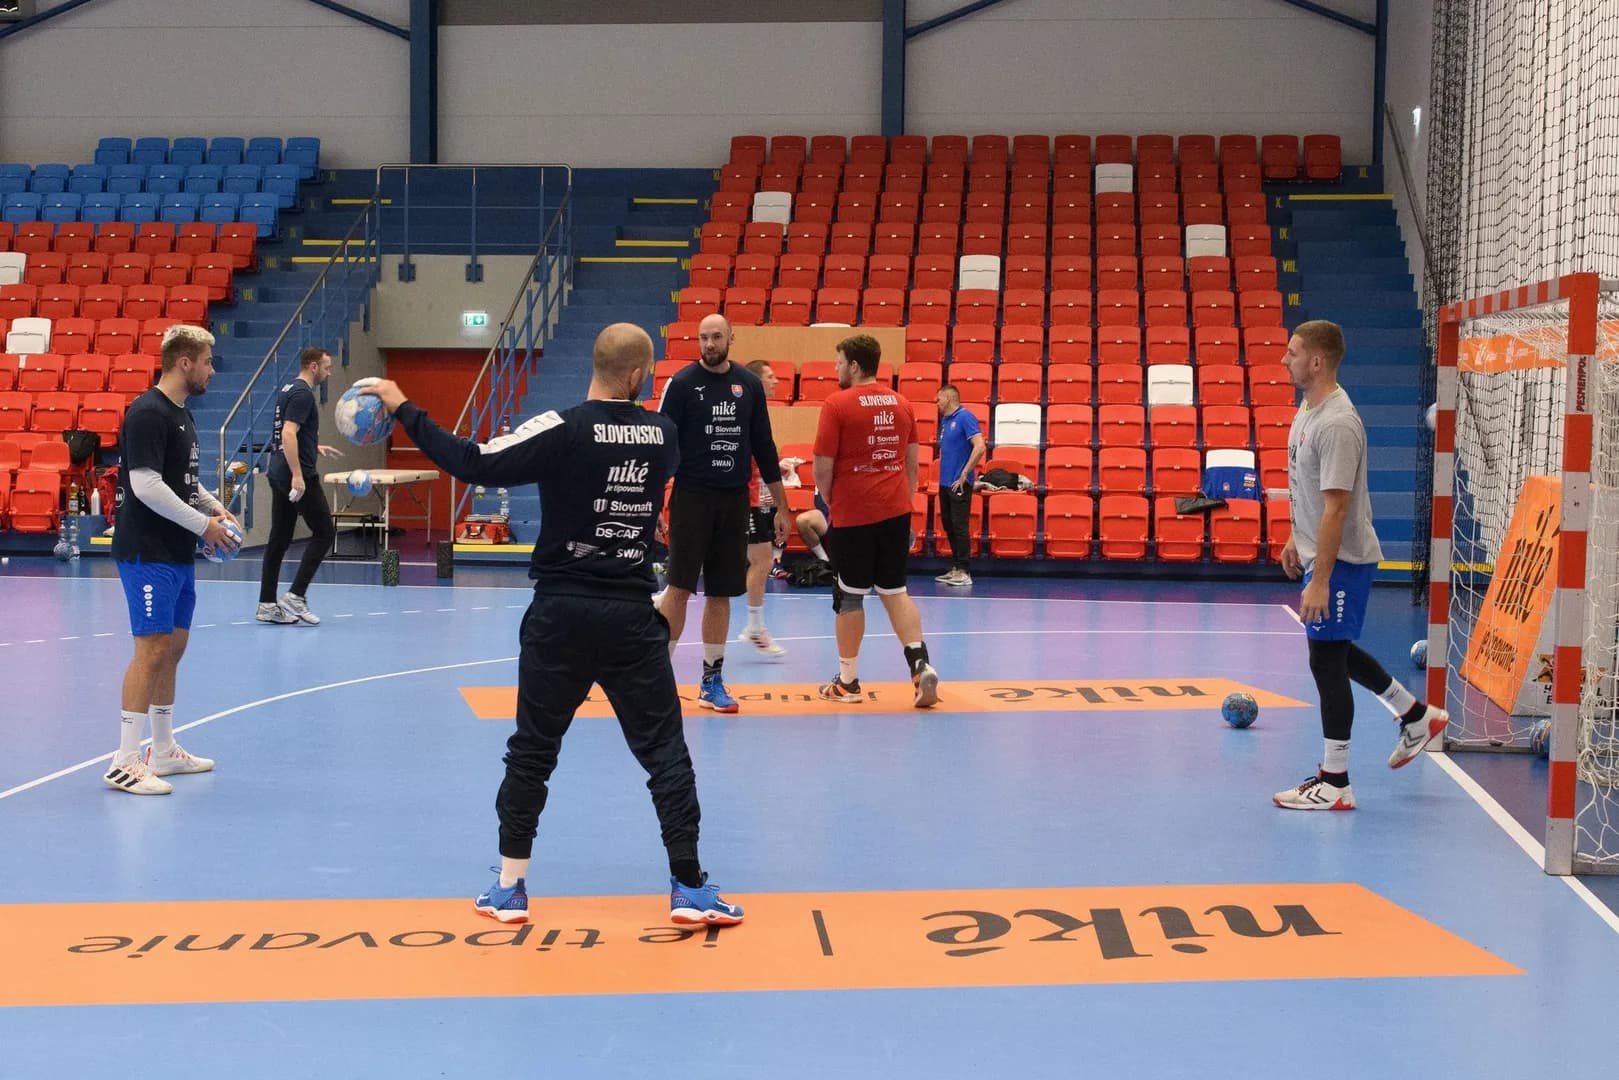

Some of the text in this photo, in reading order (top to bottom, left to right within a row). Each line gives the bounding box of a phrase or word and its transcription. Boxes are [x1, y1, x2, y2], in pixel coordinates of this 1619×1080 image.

[1576, 355, 1587, 412] PESMENPOL
[712, 401, 737, 416] niké
[873, 410, 895, 426] niké
[592, 422, 665, 446] SLOVENSKO
[715, 424, 741, 434] Slovnaft
[606, 459, 650, 484] niké
[711, 459, 732, 467] SWAN
[613, 484, 645, 494] tipovanie
[610, 500, 653, 513] Slovnaft
[984, 685, 1207, 705] niké
[67, 923, 607, 960] tipovanie
[921, 904, 1343, 961] niké
